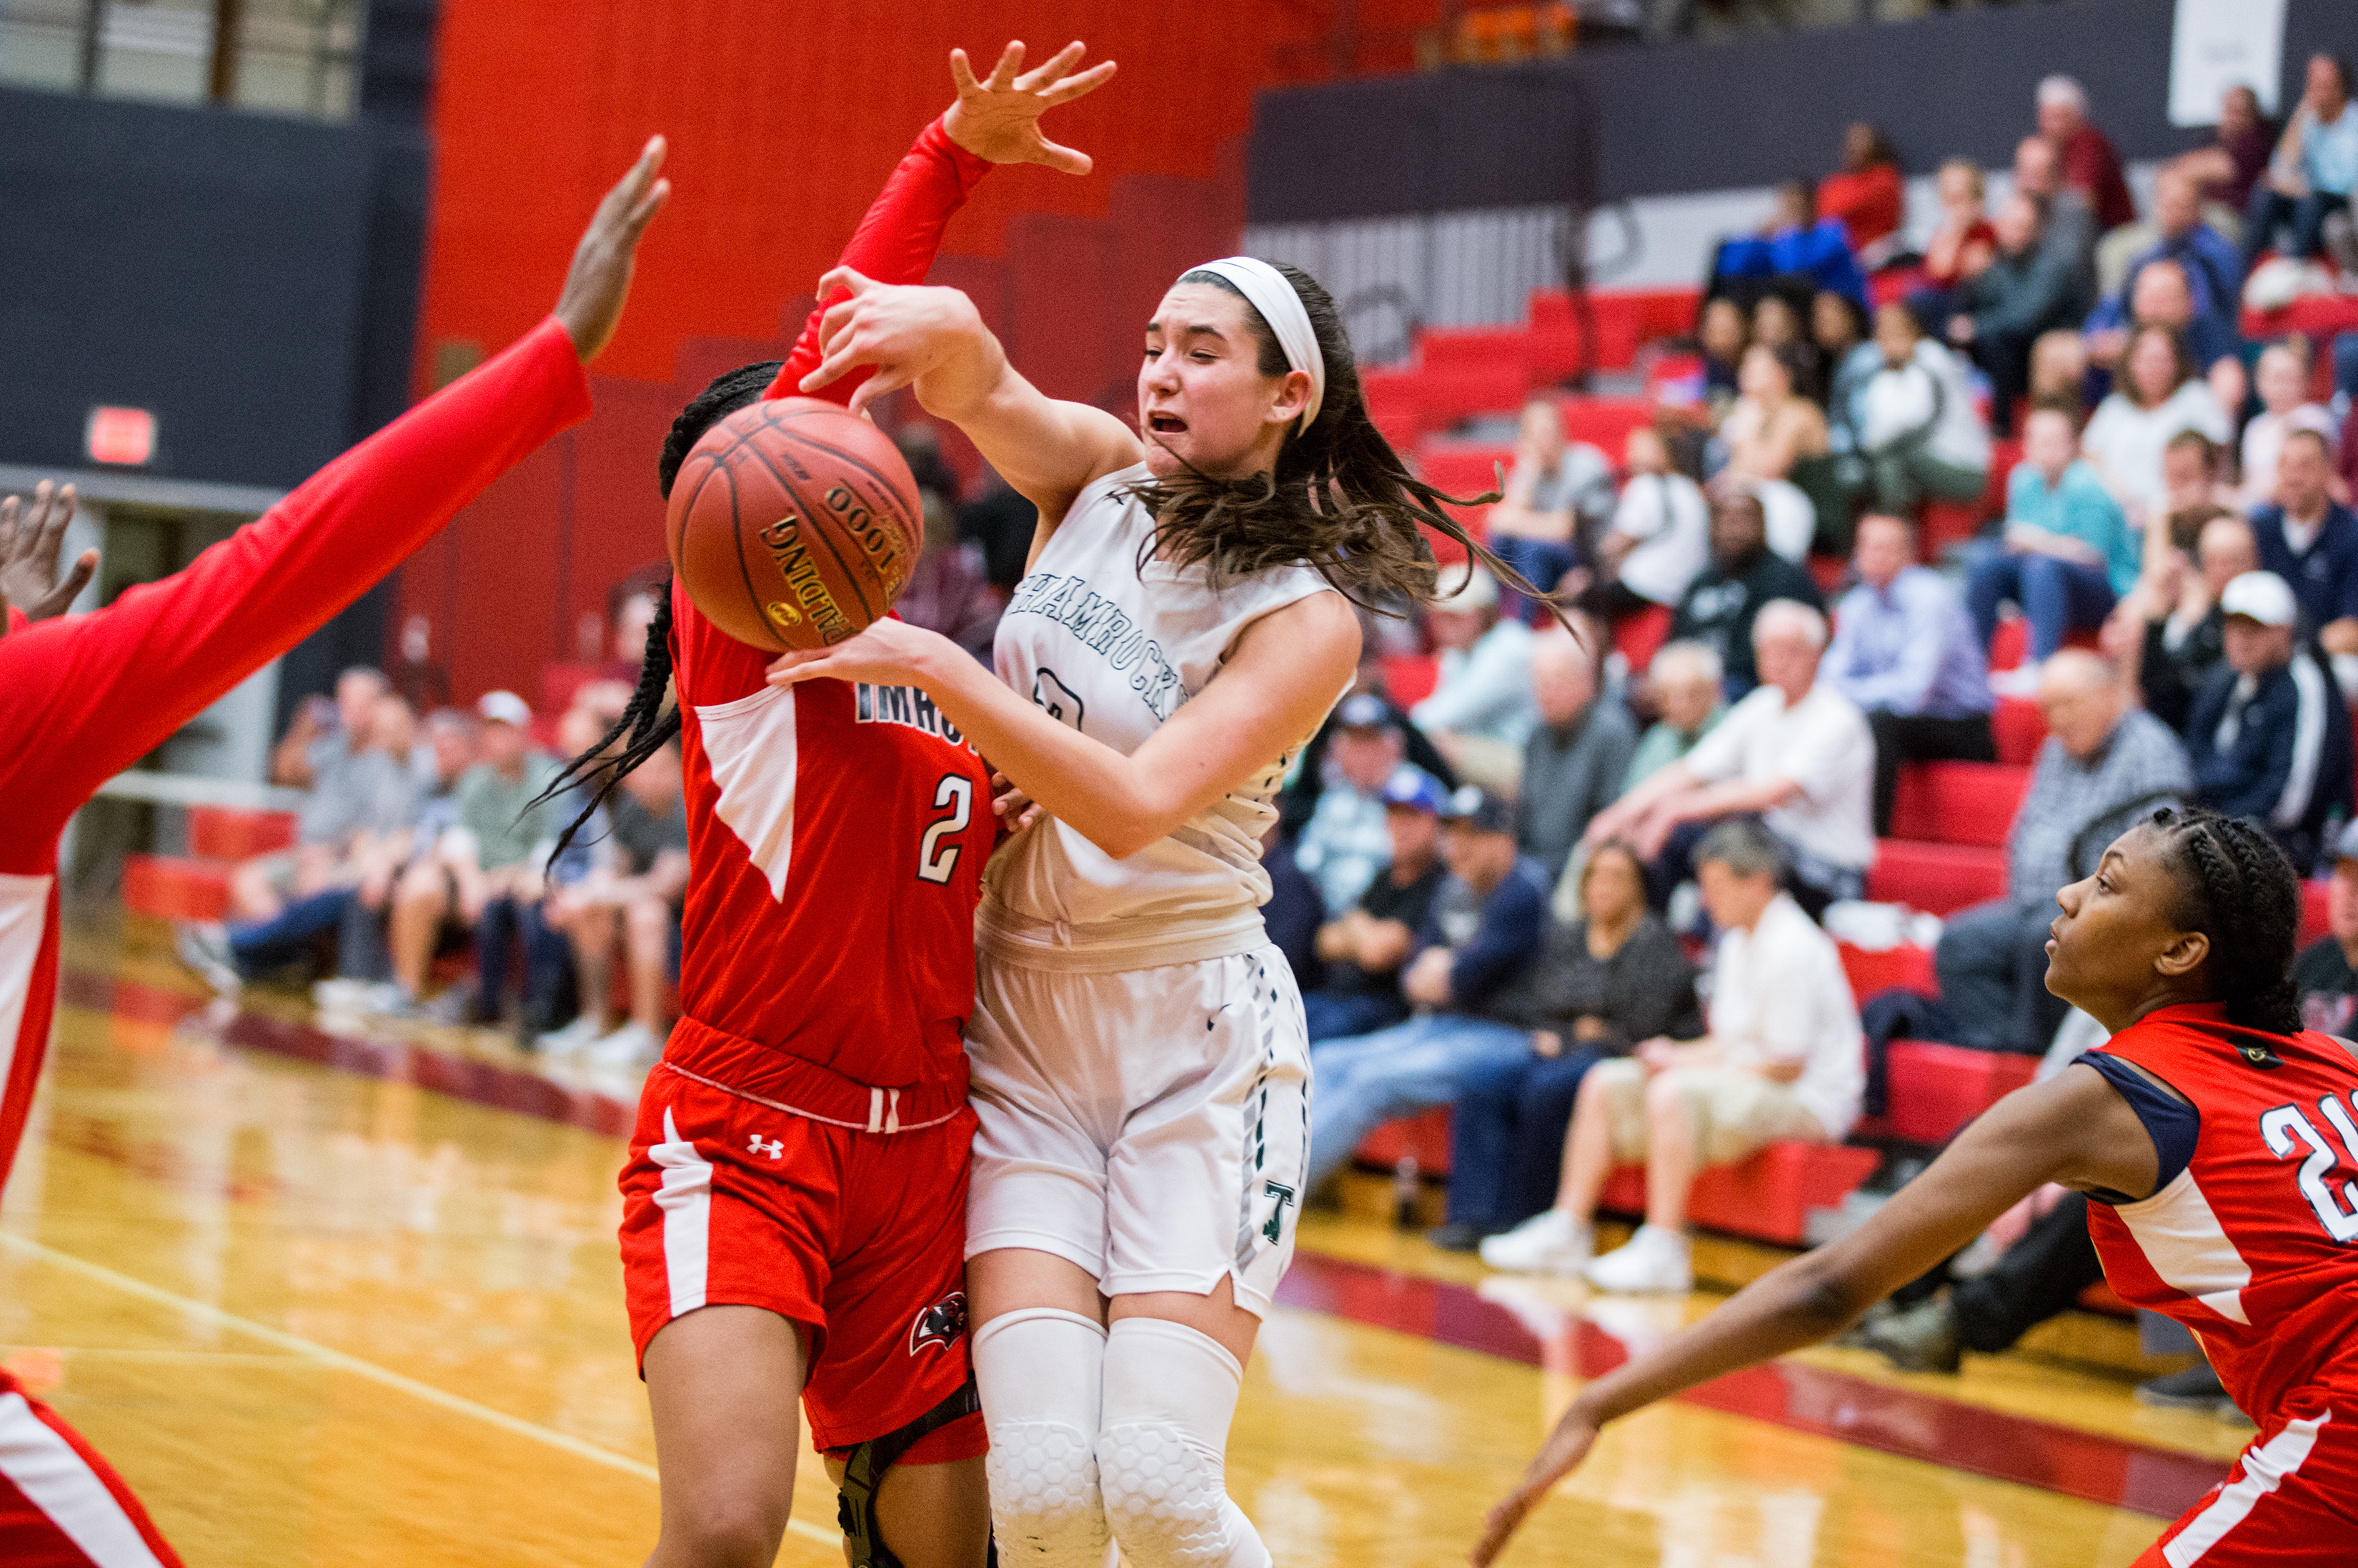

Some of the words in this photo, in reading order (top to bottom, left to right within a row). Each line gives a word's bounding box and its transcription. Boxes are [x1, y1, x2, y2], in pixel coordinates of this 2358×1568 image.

[759, 514, 862, 648] PALDING
[1007, 573, 1189, 723] HAMROCK
[915, 771, 973, 887] 2
